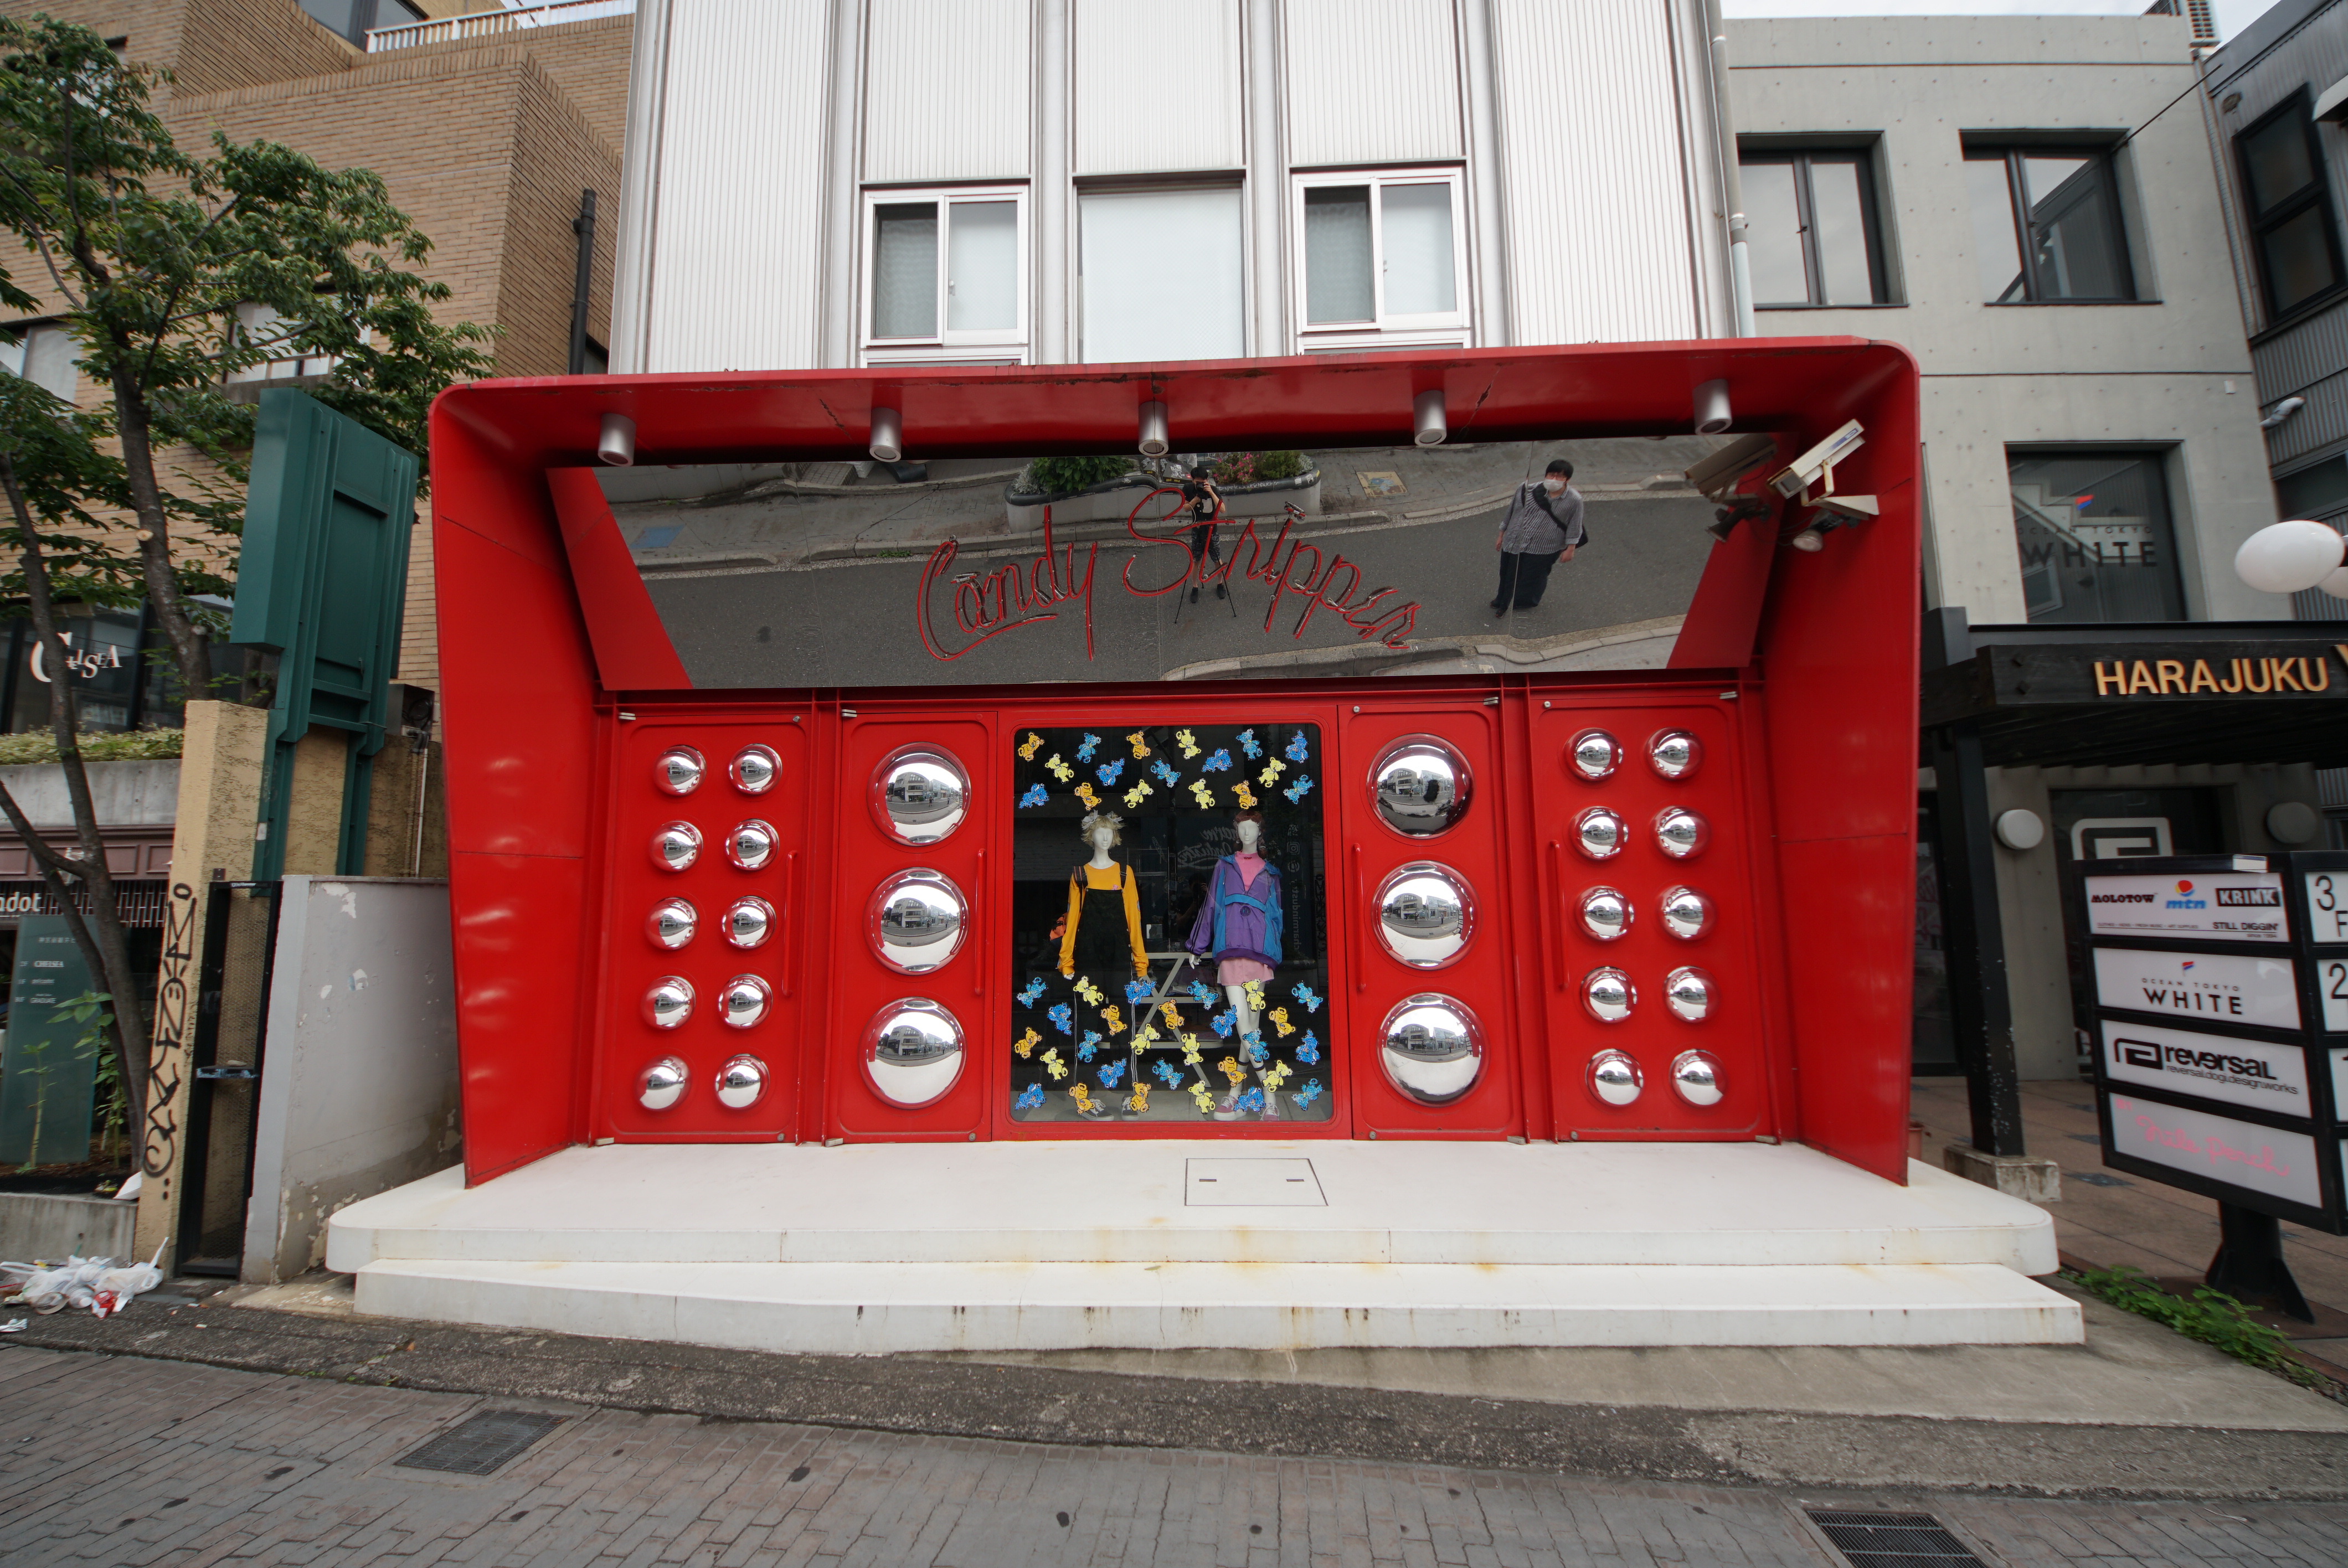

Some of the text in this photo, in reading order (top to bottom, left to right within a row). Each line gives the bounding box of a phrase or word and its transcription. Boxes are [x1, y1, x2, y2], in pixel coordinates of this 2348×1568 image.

[2093, 525, 2153, 534] TOKYO
[2019, 541, 2158, 568] WHITE
[917, 487, 1422, 662] Candy Stripper
[2094, 657, 2329, 696] HARAJUKU
[2091, 895, 2154, 903] MOLOTOW
[2165, 900, 2206, 909] mtn
[2218, 890, 2278, 905] KRINK
[2315, 875, 2335, 911] 3
[2193, 982, 2239, 991] TOKYO
[2329, 963, 2348, 999] 2
[2143, 988, 2242, 1015] WHITE
